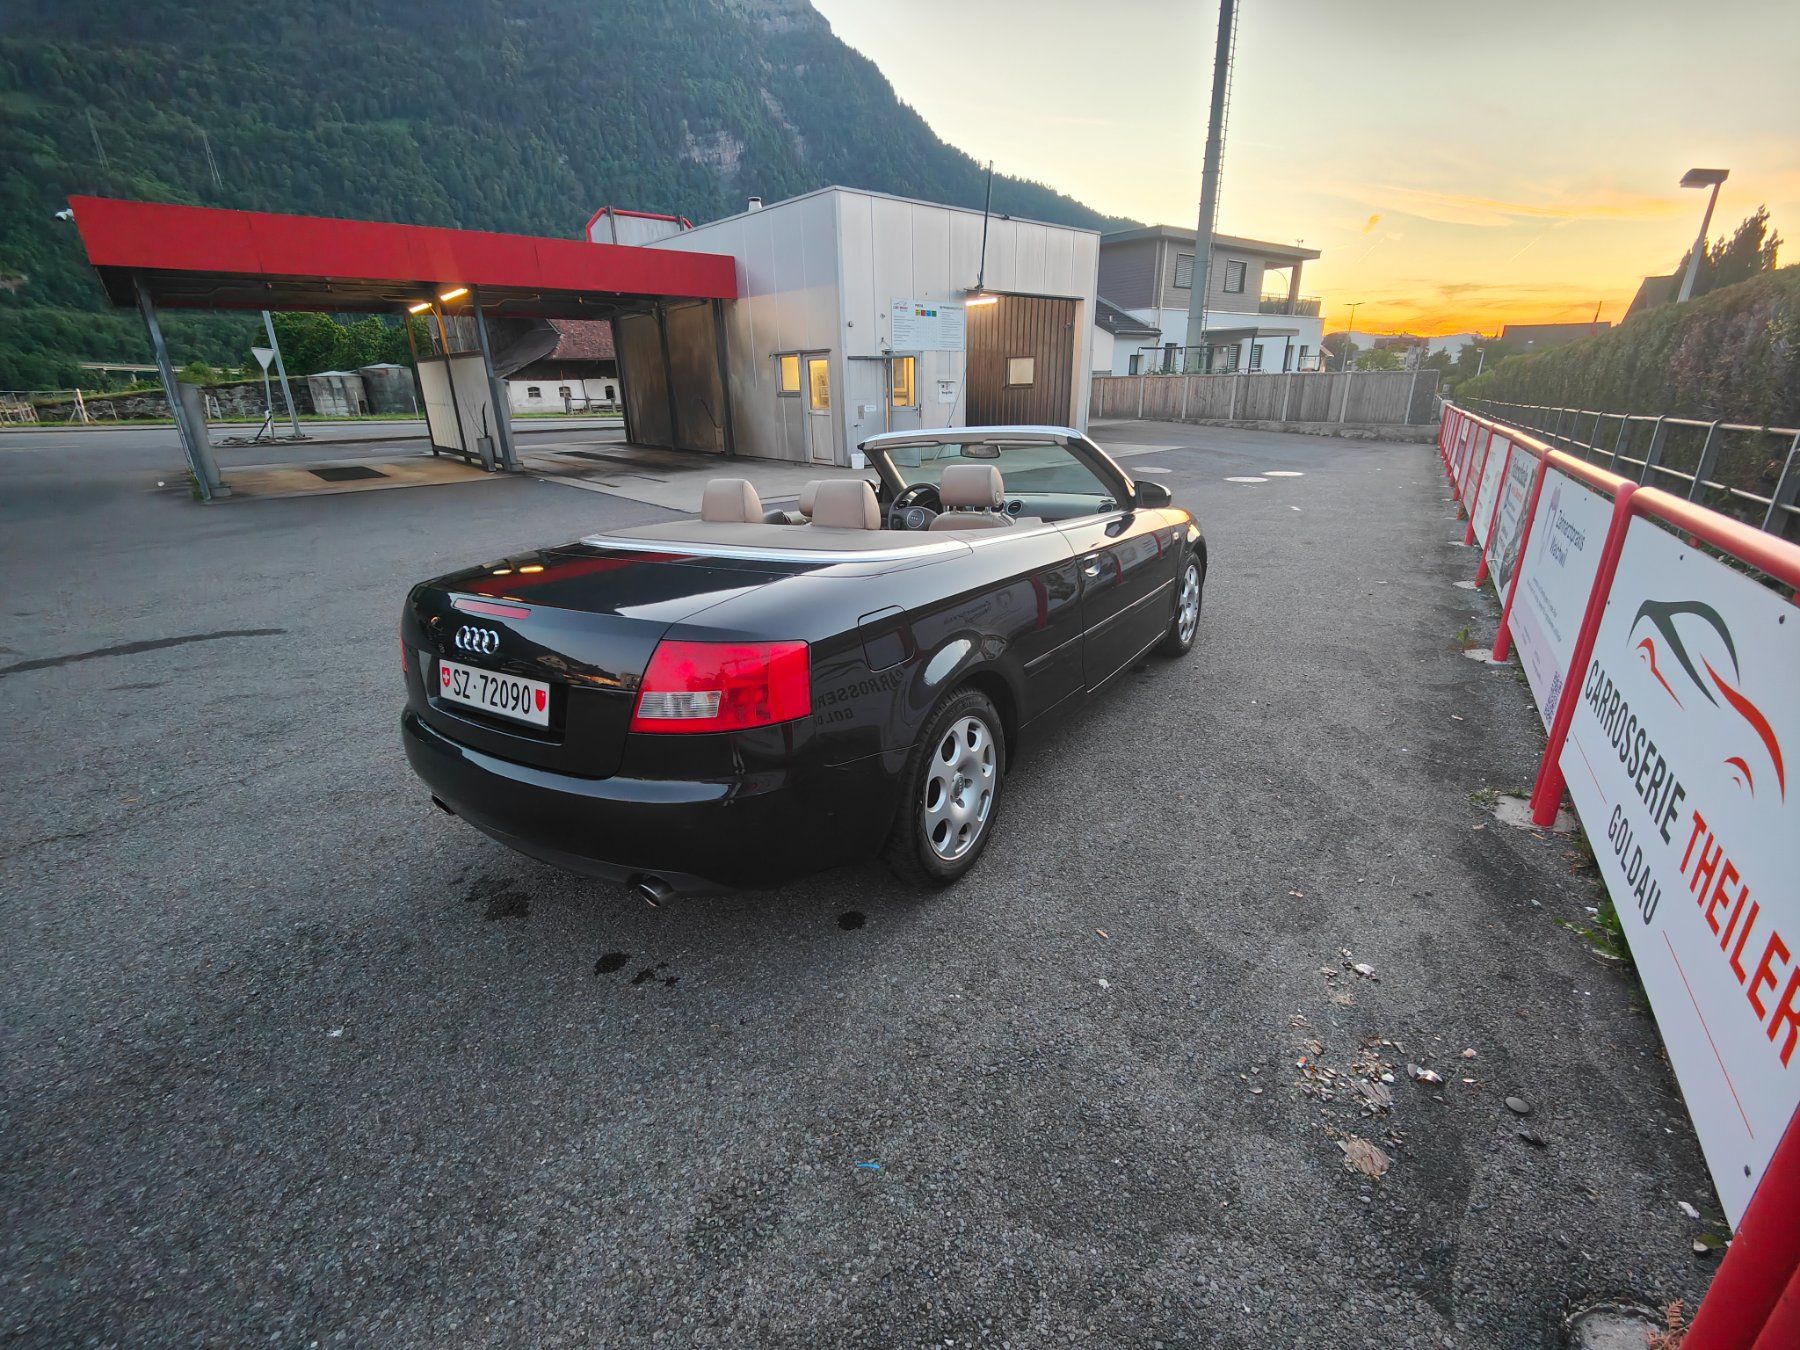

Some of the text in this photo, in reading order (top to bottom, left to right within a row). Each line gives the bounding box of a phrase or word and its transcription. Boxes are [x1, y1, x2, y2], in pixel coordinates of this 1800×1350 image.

[1585, 659, 1800, 1070] CARROSSERIE THEILER
[1607, 803, 1662, 925] GOLDAU
